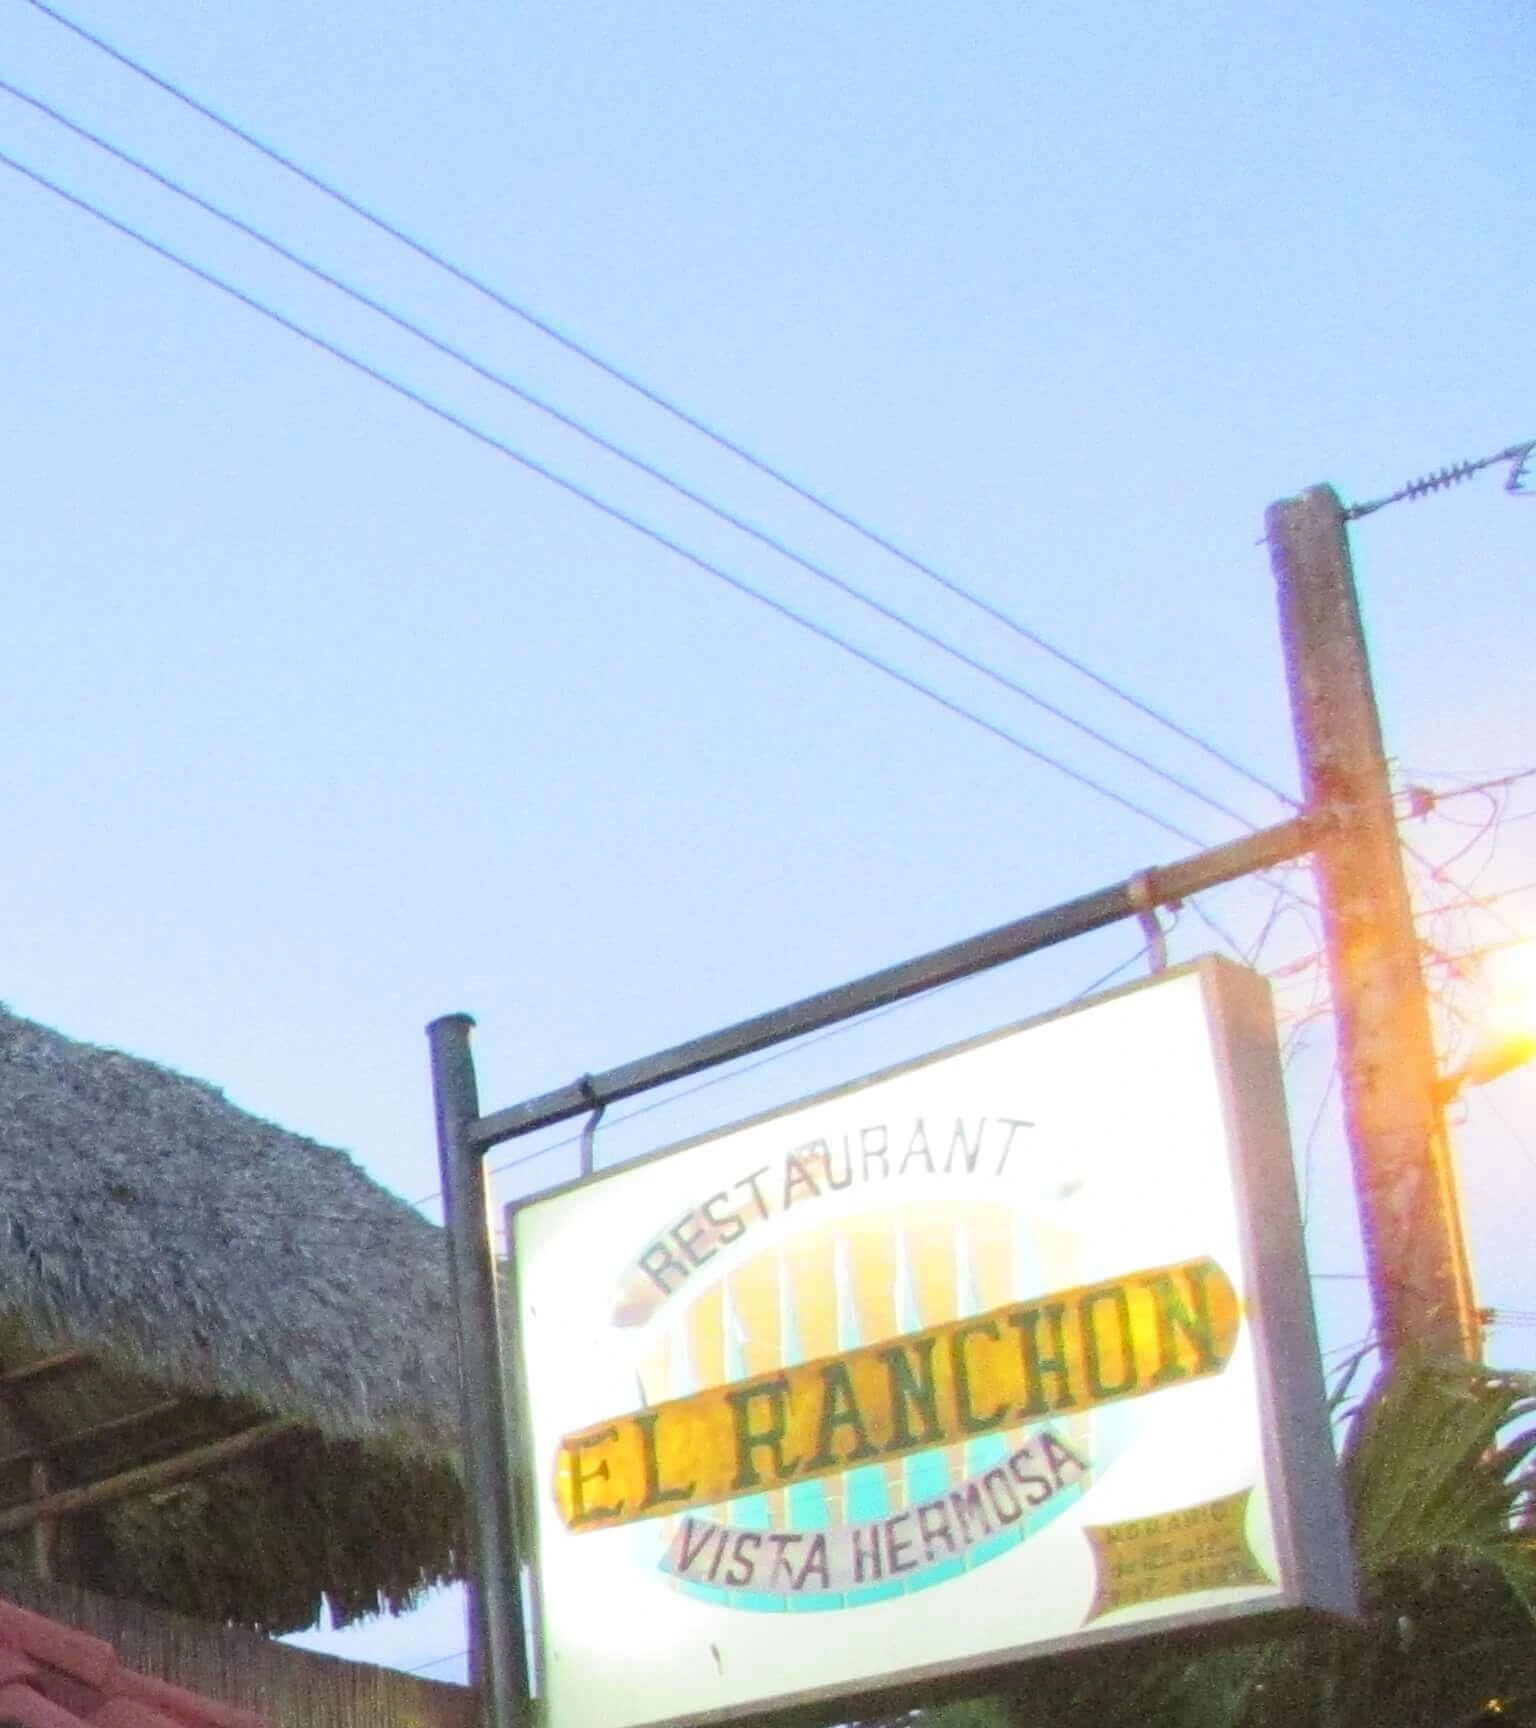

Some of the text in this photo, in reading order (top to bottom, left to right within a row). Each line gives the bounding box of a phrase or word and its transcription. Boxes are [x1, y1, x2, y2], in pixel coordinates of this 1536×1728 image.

[639, 1116, 1034, 1295] RESTAURANT
[563, 1263, 1230, 1519] EL RANCHON
[675, 1516, 830, 1591] VISTA
[850, 1431, 1089, 1584] HERMOSA
